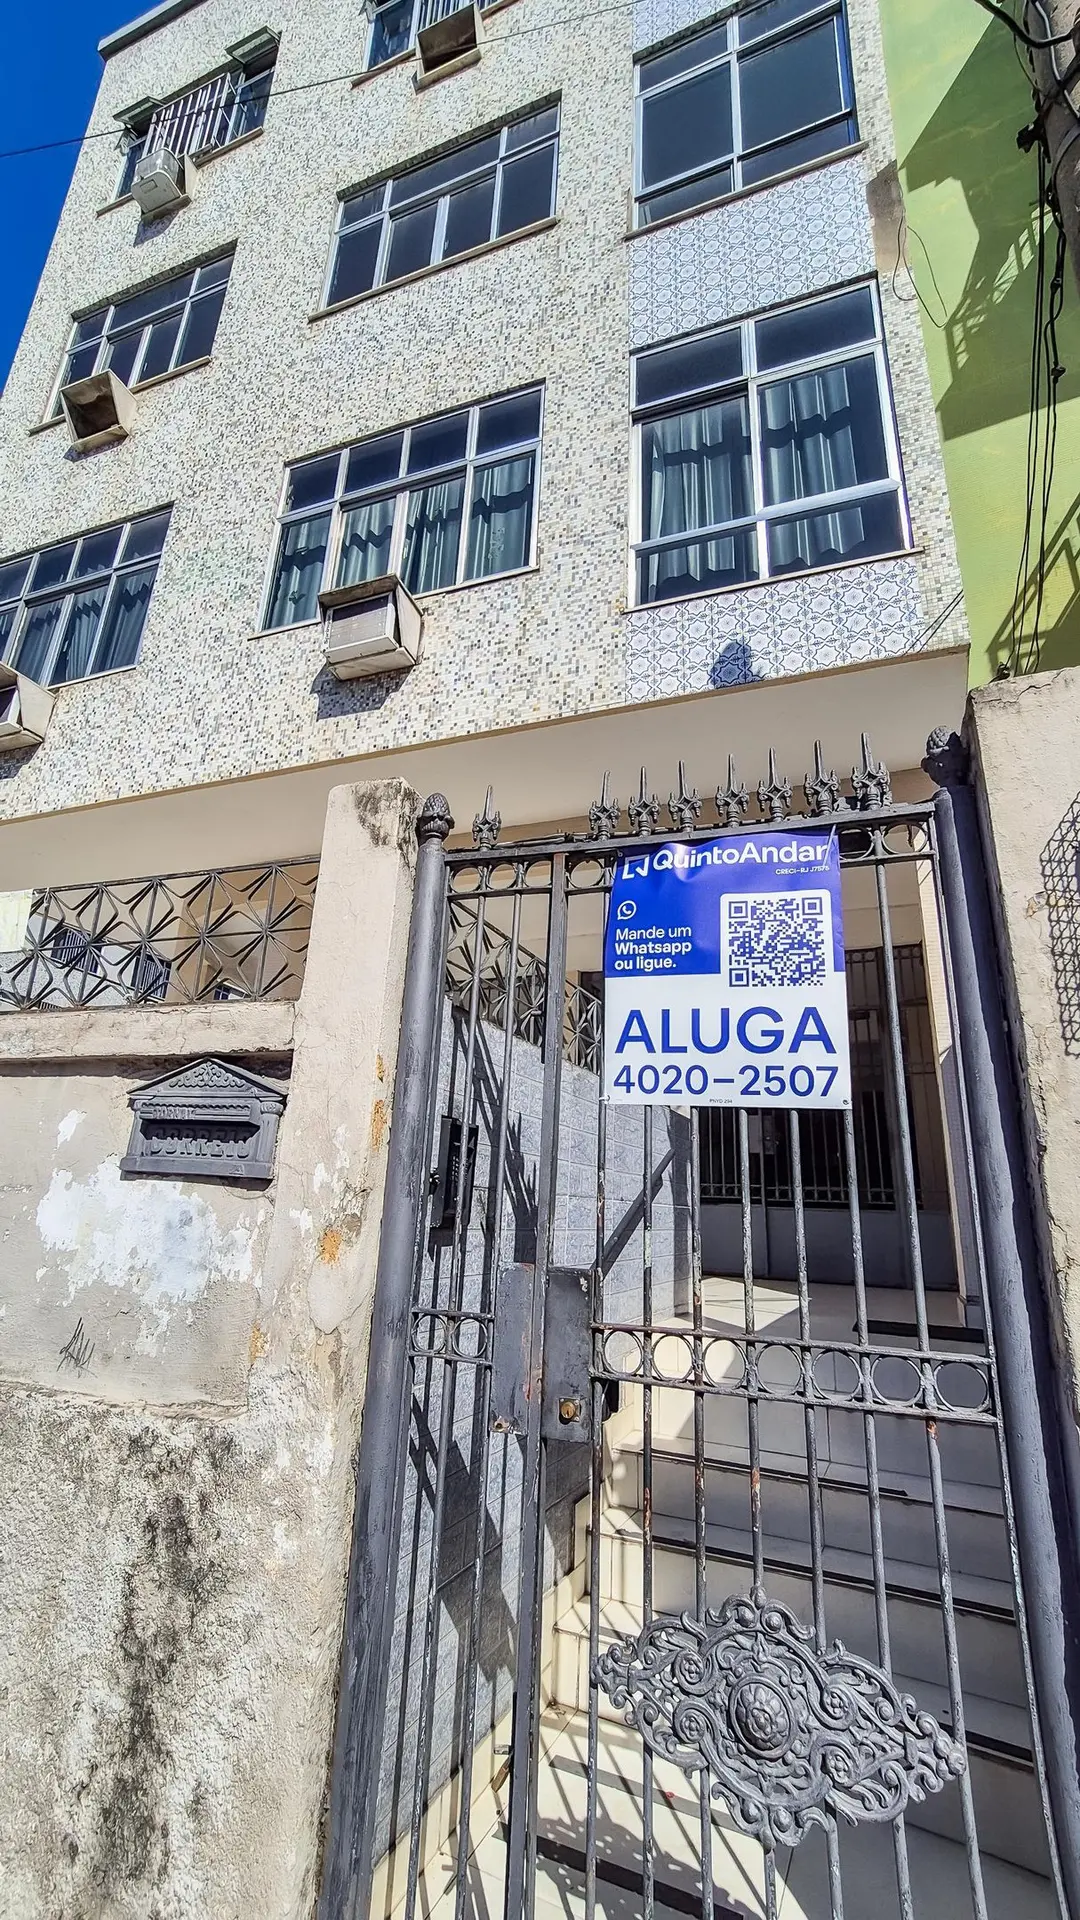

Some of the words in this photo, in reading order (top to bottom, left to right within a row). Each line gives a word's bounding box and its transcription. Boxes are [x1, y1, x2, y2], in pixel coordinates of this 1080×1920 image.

[652, 840, 828, 871] QuintoAndar
[775, 866, 809, 876] CRECI-RJ
[615, 926, 664, 942] Mande
[668, 926, 692, 938] um
[614, 940, 692, 957] Whatsapp
[614, 960, 634, 971] ou
[636, 955, 677, 973] ligue.
[614, 1005, 837, 1055] ALUGA
[613, 1064, 839, 1097] 4020-2507
